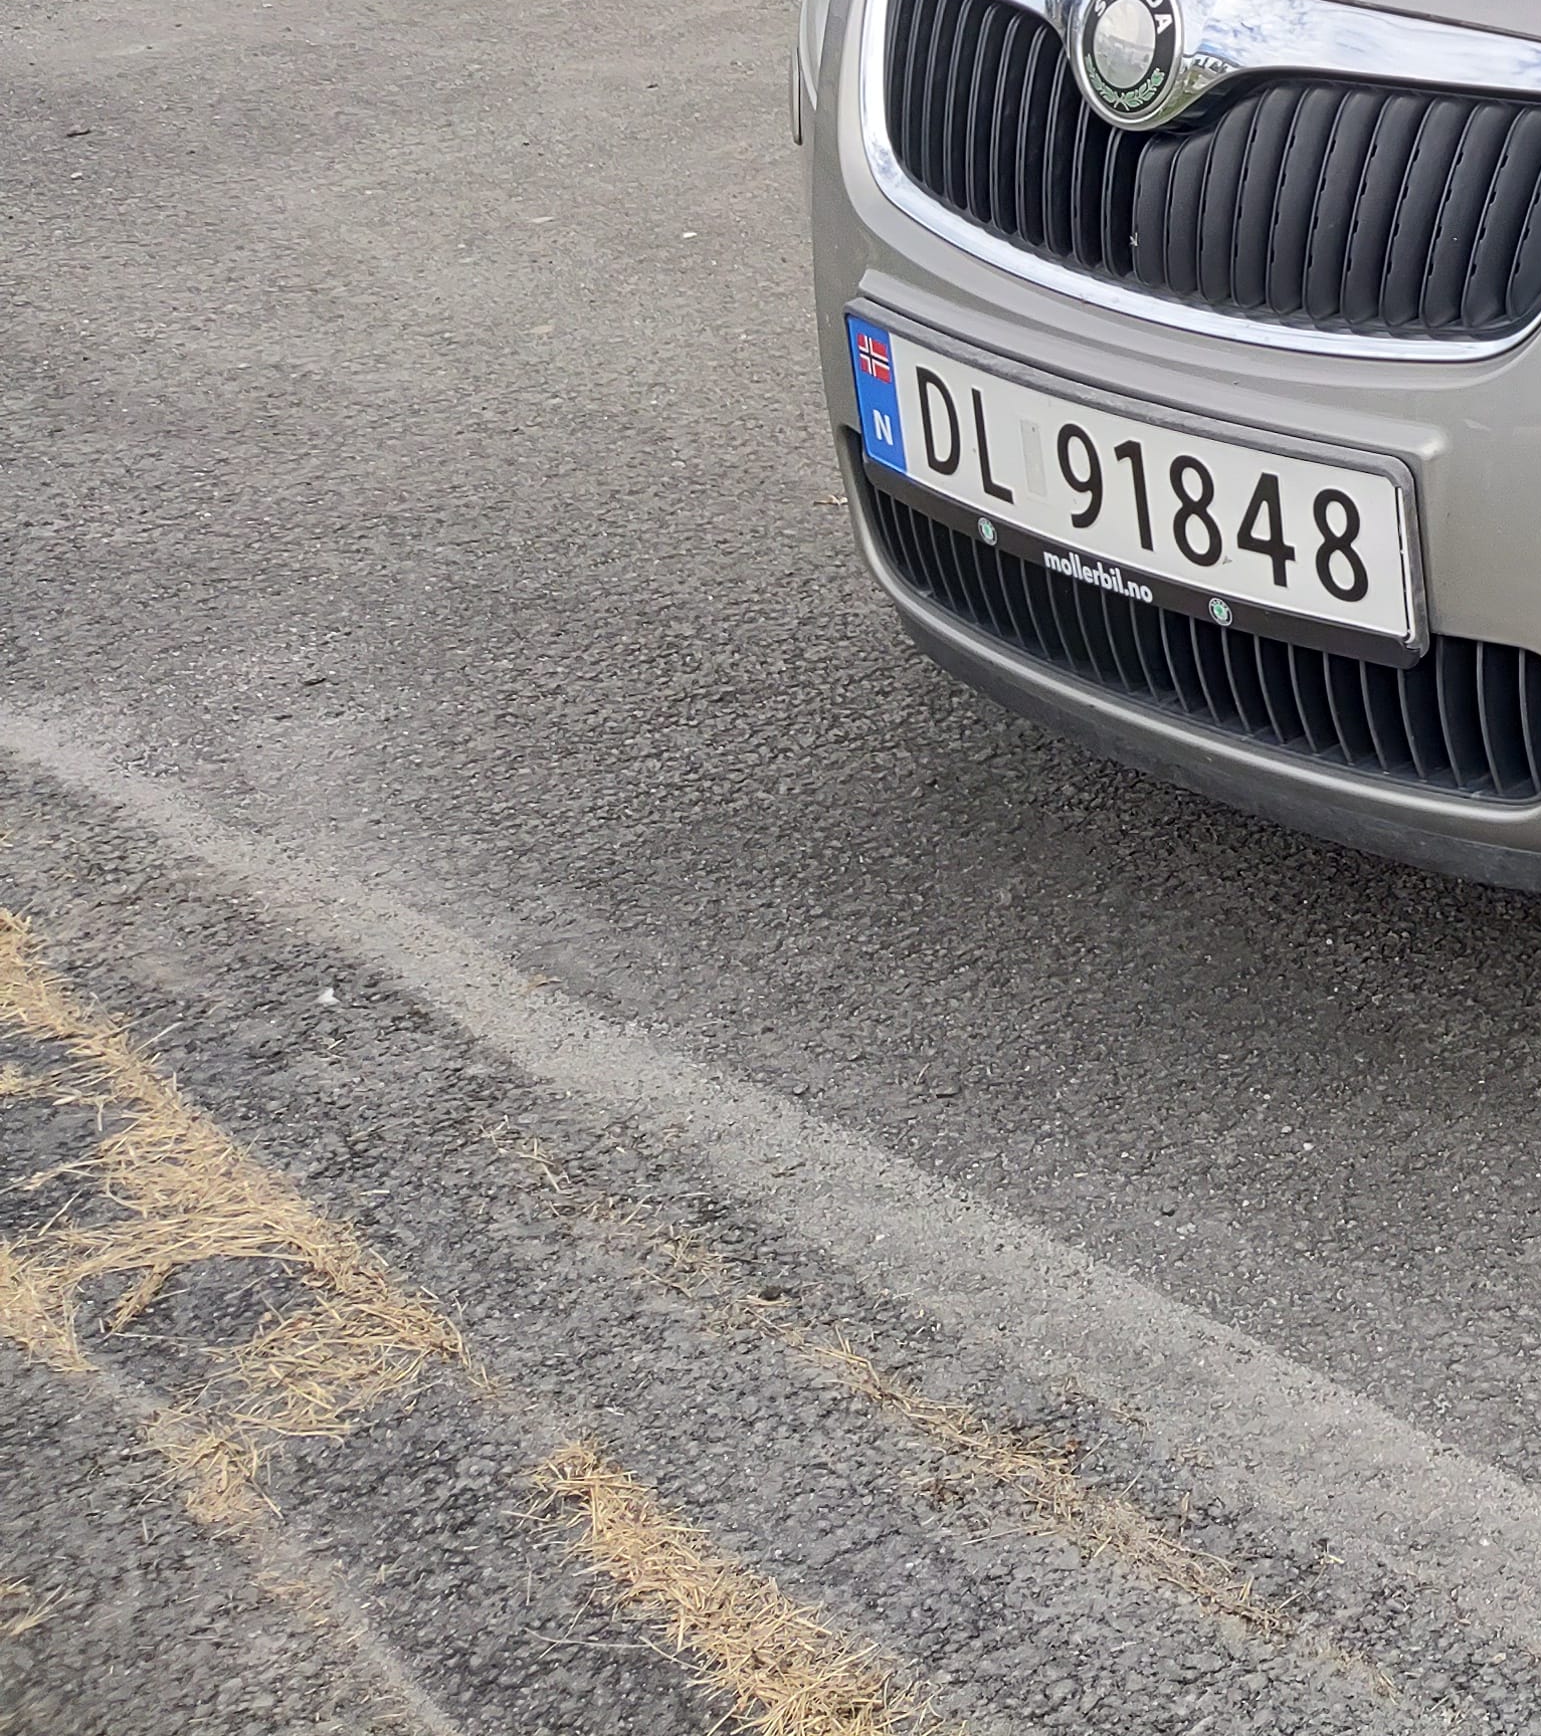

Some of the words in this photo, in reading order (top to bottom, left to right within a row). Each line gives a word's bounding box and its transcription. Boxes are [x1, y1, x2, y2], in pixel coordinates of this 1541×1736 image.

[872, 408, 894, 446] N
[916, 366, 1014, 505] DL
[1057, 423, 1369, 602] 91848
[1043, 551, 1154, 604] mollerbil.no
